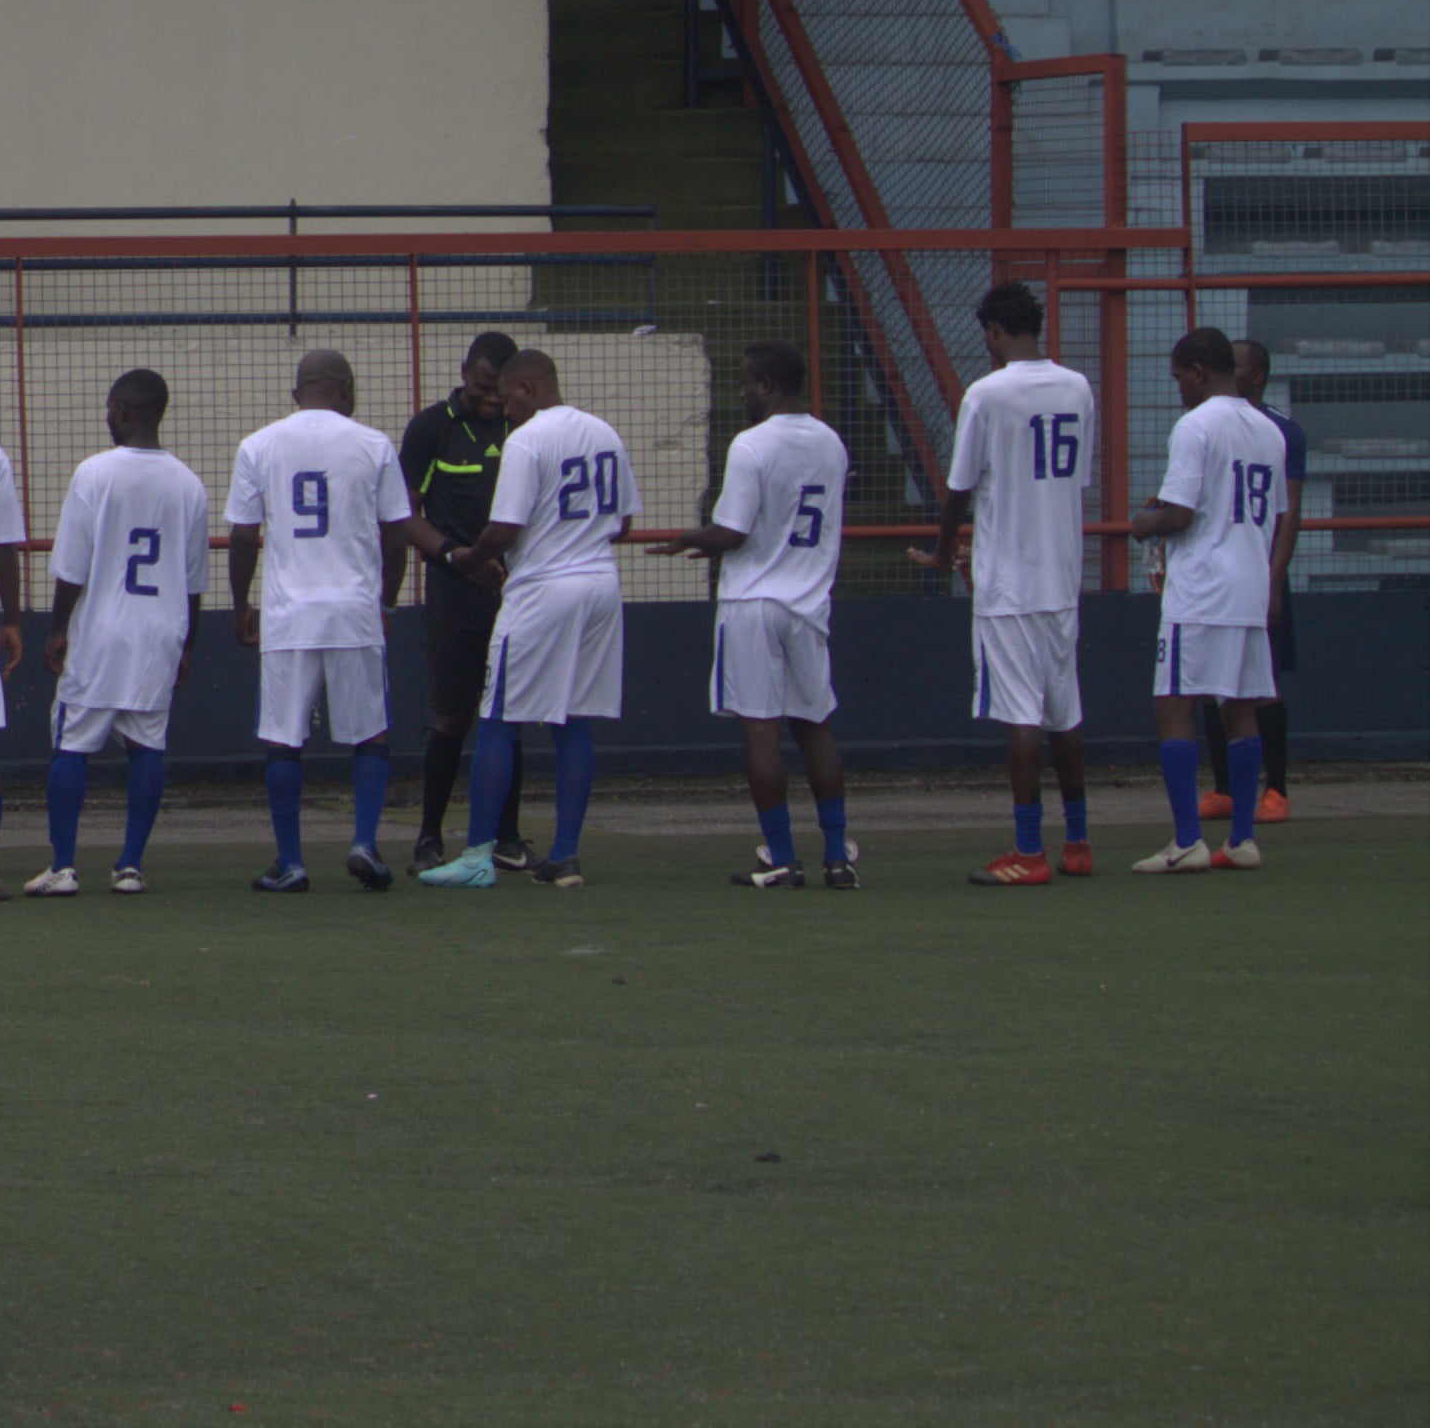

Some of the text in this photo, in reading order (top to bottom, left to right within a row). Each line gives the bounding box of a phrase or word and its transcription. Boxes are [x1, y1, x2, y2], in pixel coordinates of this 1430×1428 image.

[1029, 414, 1078, 479] 16
[292, 471, 329, 538] 9
[558, 451, 619, 521] 20
[788, 485, 825, 547] 5
[1232, 459, 1273, 525] 18
[125, 528, 160, 596] 2
